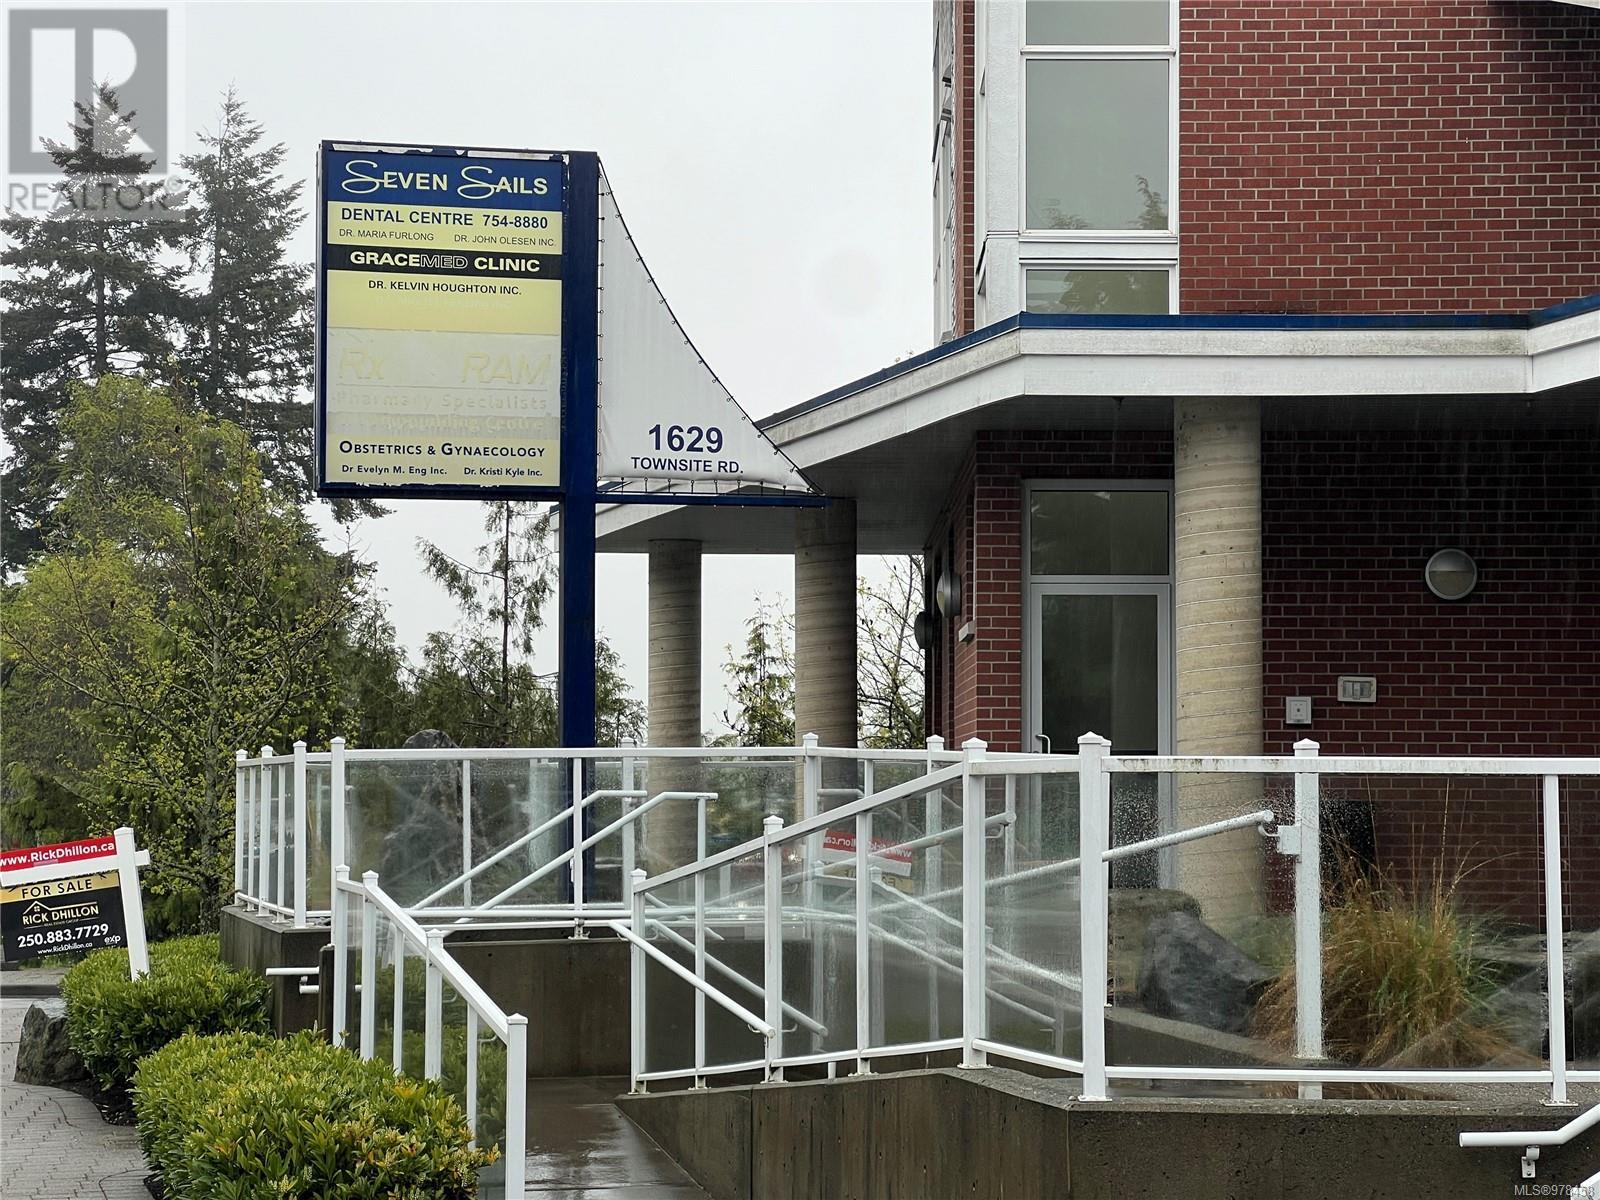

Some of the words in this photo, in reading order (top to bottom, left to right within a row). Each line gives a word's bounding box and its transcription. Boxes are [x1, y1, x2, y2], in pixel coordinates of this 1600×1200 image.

[341, 160, 448, 194] SEVEN
[457, 166, 548, 199] SAILS
[341, 208, 404, 223] DENTAL
[409, 211, 473, 226] CENTRE
[482, 214, 548, 229] 754-8880
[339, 229, 356, 238] DR.
[358, 230, 388, 239] MARIA
[389, 231, 434, 241] FURLONG
[454, 234, 470, 243] DR.
[472, 235, 497, 244] JOHN
[499, 236, 536, 246] OLESEN
[538, 238, 557, 247] INC.
[350, 251, 468, 269] GRACEMED
[474, 257, 540, 272] CLINIC
[368, 280, 387, 290] DR.
[390, 281, 429, 291] KELVIN
[432, 283, 496, 294] HOUGHTON
[499, 286, 522, 295] INC.
[339, 440, 422, 455] OBSTETRICS
[427, 445, 436, 455] &
[441, 442, 545, 457] GYNAECOLOGY
[649, 424, 723, 453] 1629
[342, 465, 354, 473] Dr
[357, 465, 389, 474] Evelyn
[393, 466, 405, 474] M.
[409, 466, 427, 476] Eng
[430, 467, 448, 475] Inc.
[464, 467, 477, 476] Dr.
[479, 467, 503, 476] Kristi
[505, 468, 525, 477] Kyle
[527, 468, 543, 476] Inc.
[631, 457, 712, 472] TOWNSITE
[717, 461, 744, 474] RD.
[0, 842, 115, 866] www.RickDhillon.ca
[21, 886, 51, 899] FOR
[57, 879, 93, 894] SALE
[22, 912, 49, 925] RICK
[52, 905, 99, 921] DHILLON
[17, 924, 109, 948] 250.883.7729
